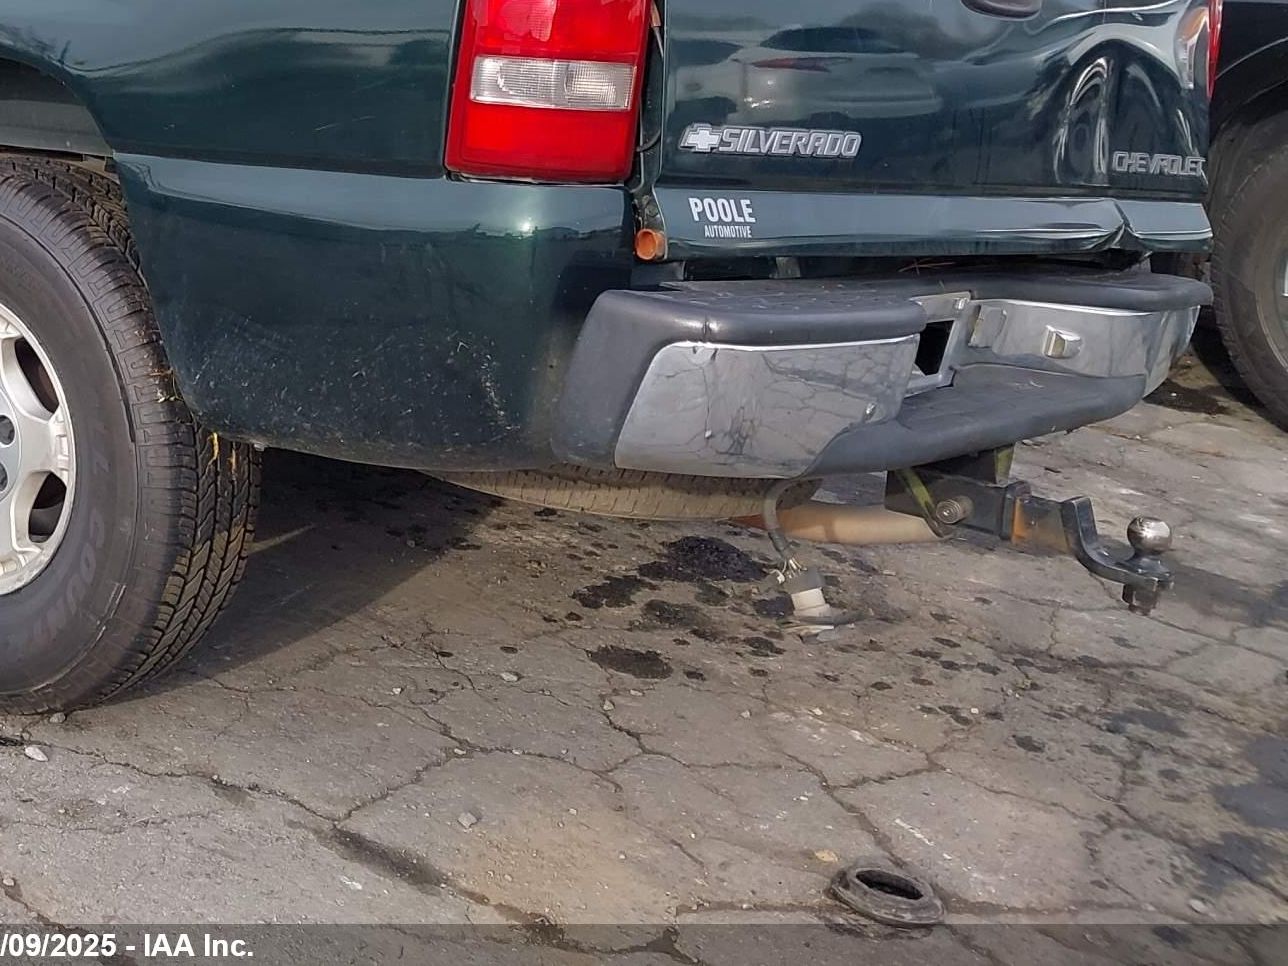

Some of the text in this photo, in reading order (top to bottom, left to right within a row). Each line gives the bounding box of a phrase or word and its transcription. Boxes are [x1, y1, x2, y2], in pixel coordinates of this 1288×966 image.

[718, 126, 862, 158] SILVERADO
[1112, 151, 1206, 176] CHEVROLET
[688, 196, 757, 224] POOLE
[703, 224, 753, 239] AUTOMOTIVE
